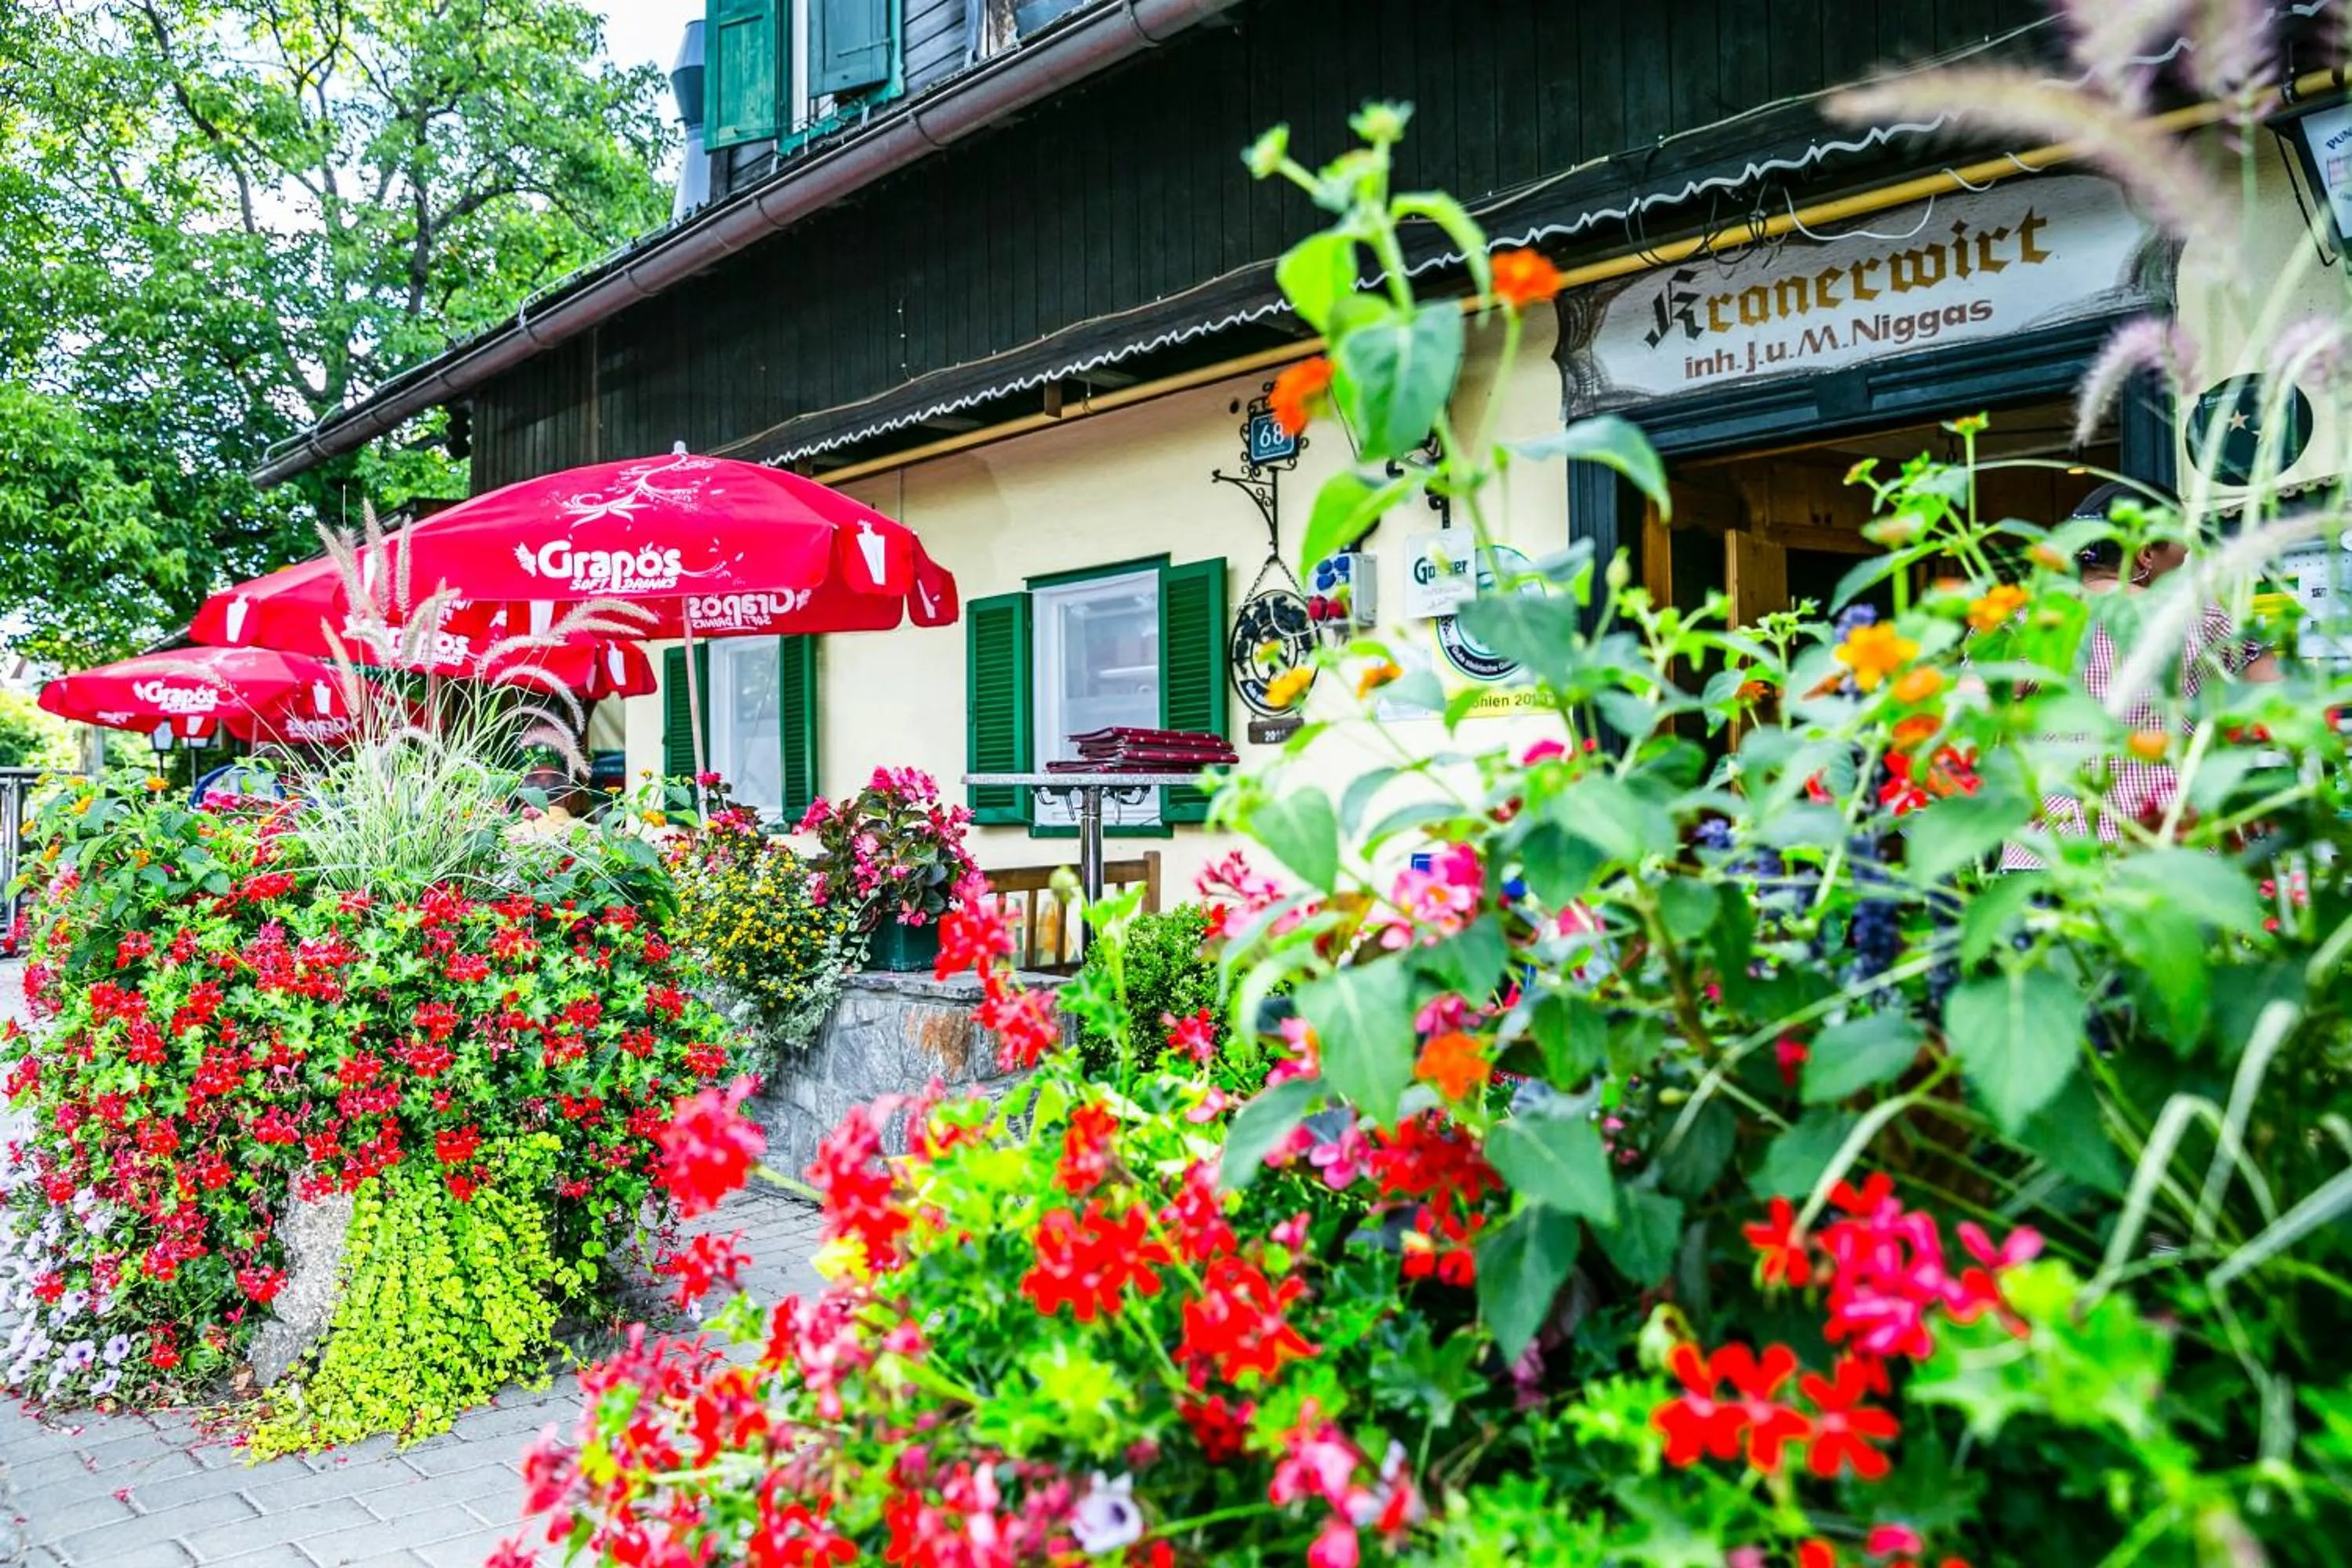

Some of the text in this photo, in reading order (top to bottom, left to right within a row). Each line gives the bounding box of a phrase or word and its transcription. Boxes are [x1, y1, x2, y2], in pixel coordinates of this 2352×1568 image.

[1644, 205, 2053, 349] Kranerwirt
[1260, 421, 1284, 448] 68
[569, 576, 677, 590] SOFT DRINKS
